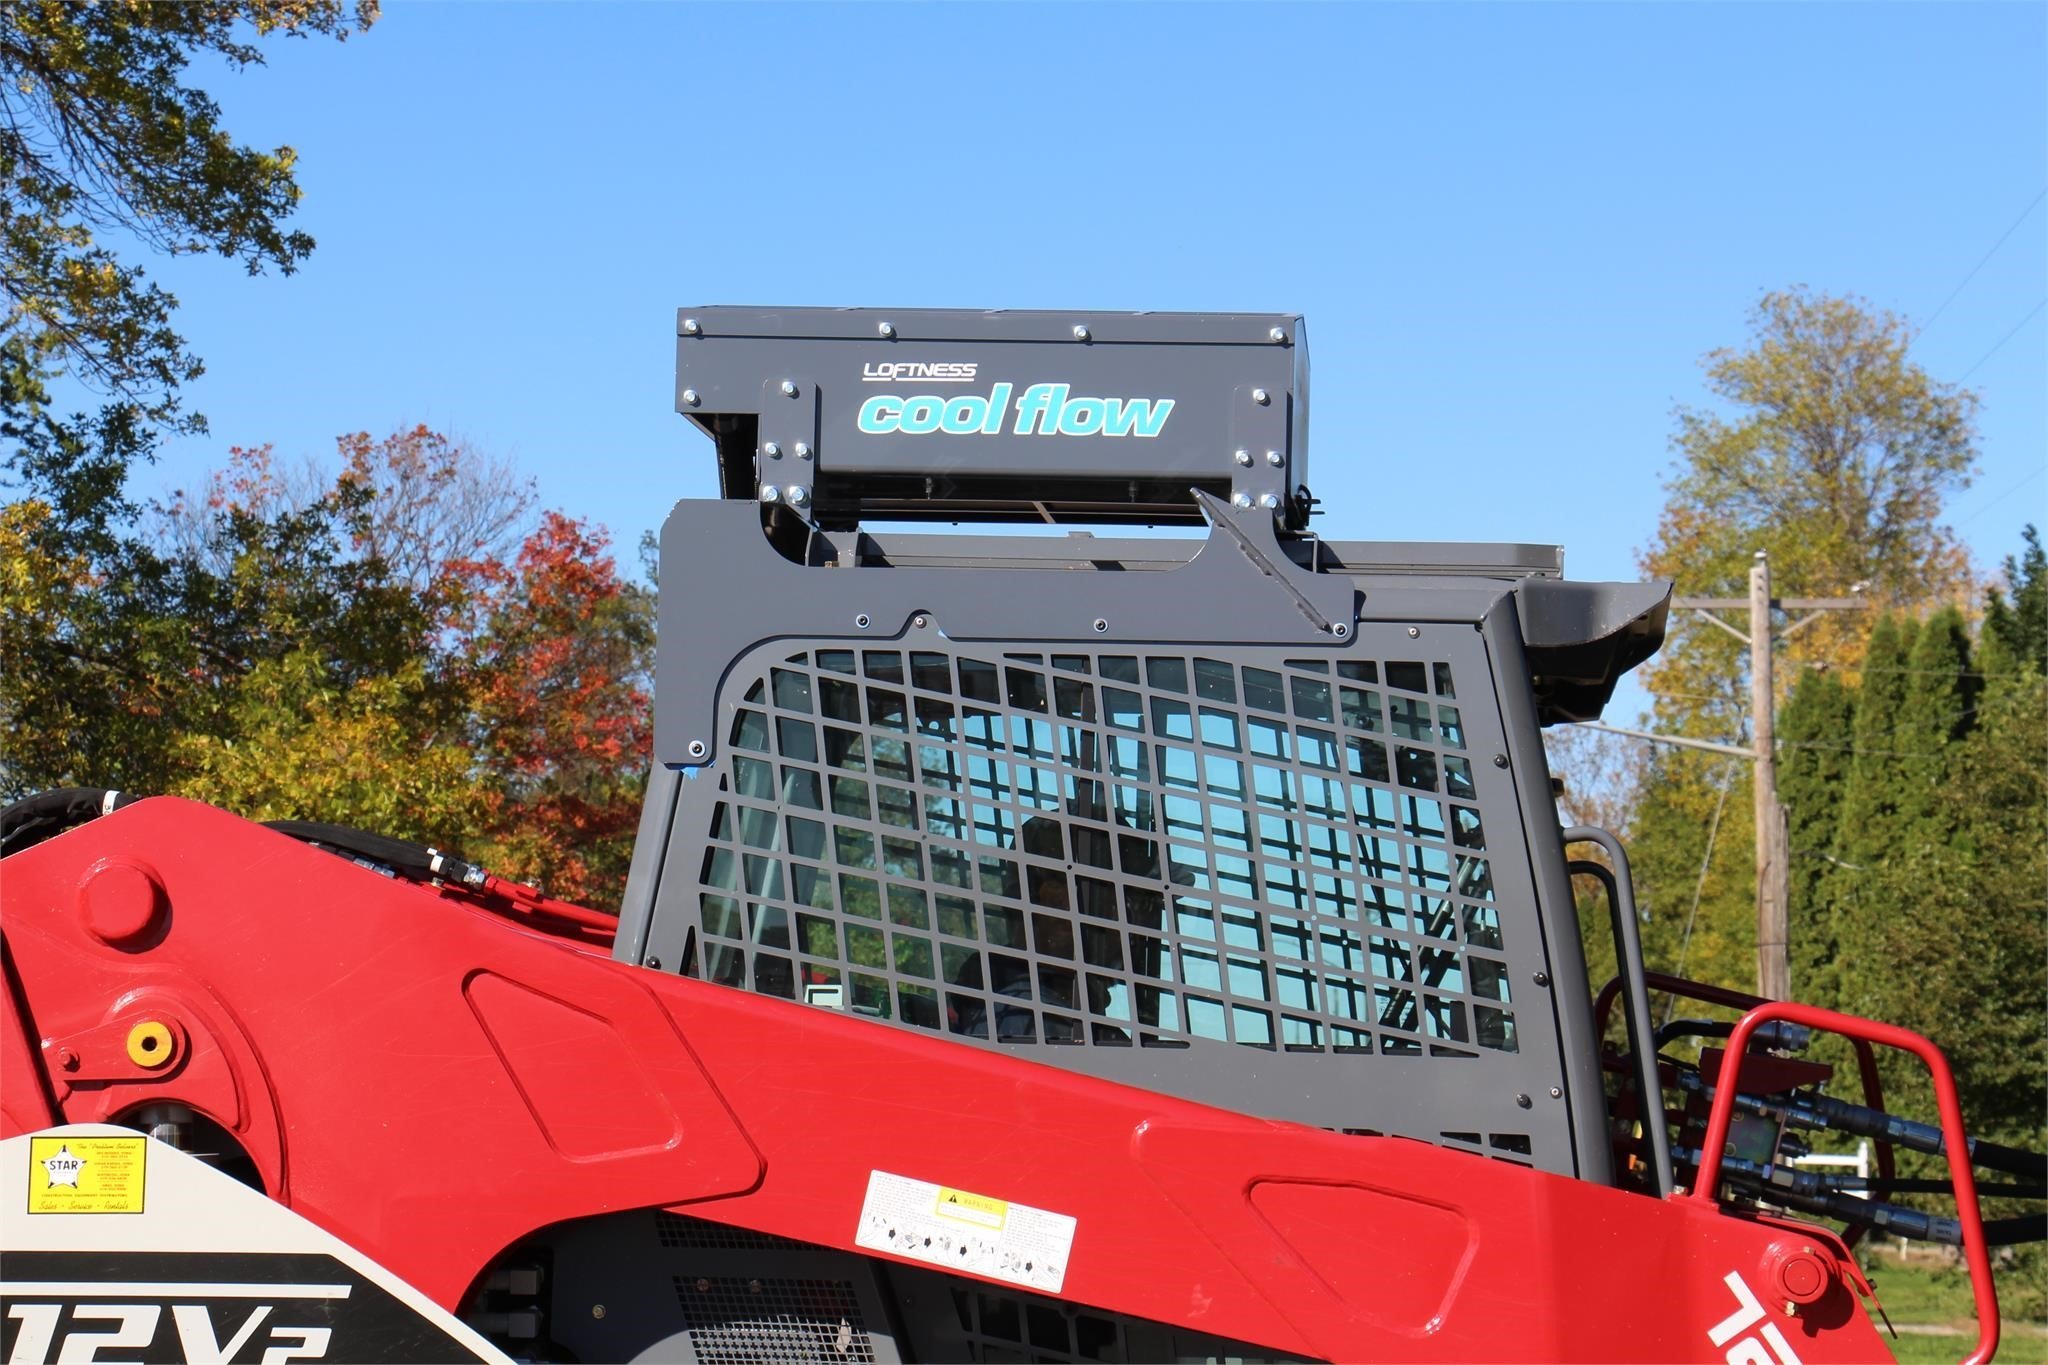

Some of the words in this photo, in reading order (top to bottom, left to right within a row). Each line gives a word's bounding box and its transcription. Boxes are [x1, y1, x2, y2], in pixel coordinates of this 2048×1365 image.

[862, 363, 978, 380] LOFTNESS
[857, 383, 1012, 434] cool
[1014, 383, 1176, 438] flow
[49, 1160, 79, 1171] STAR
